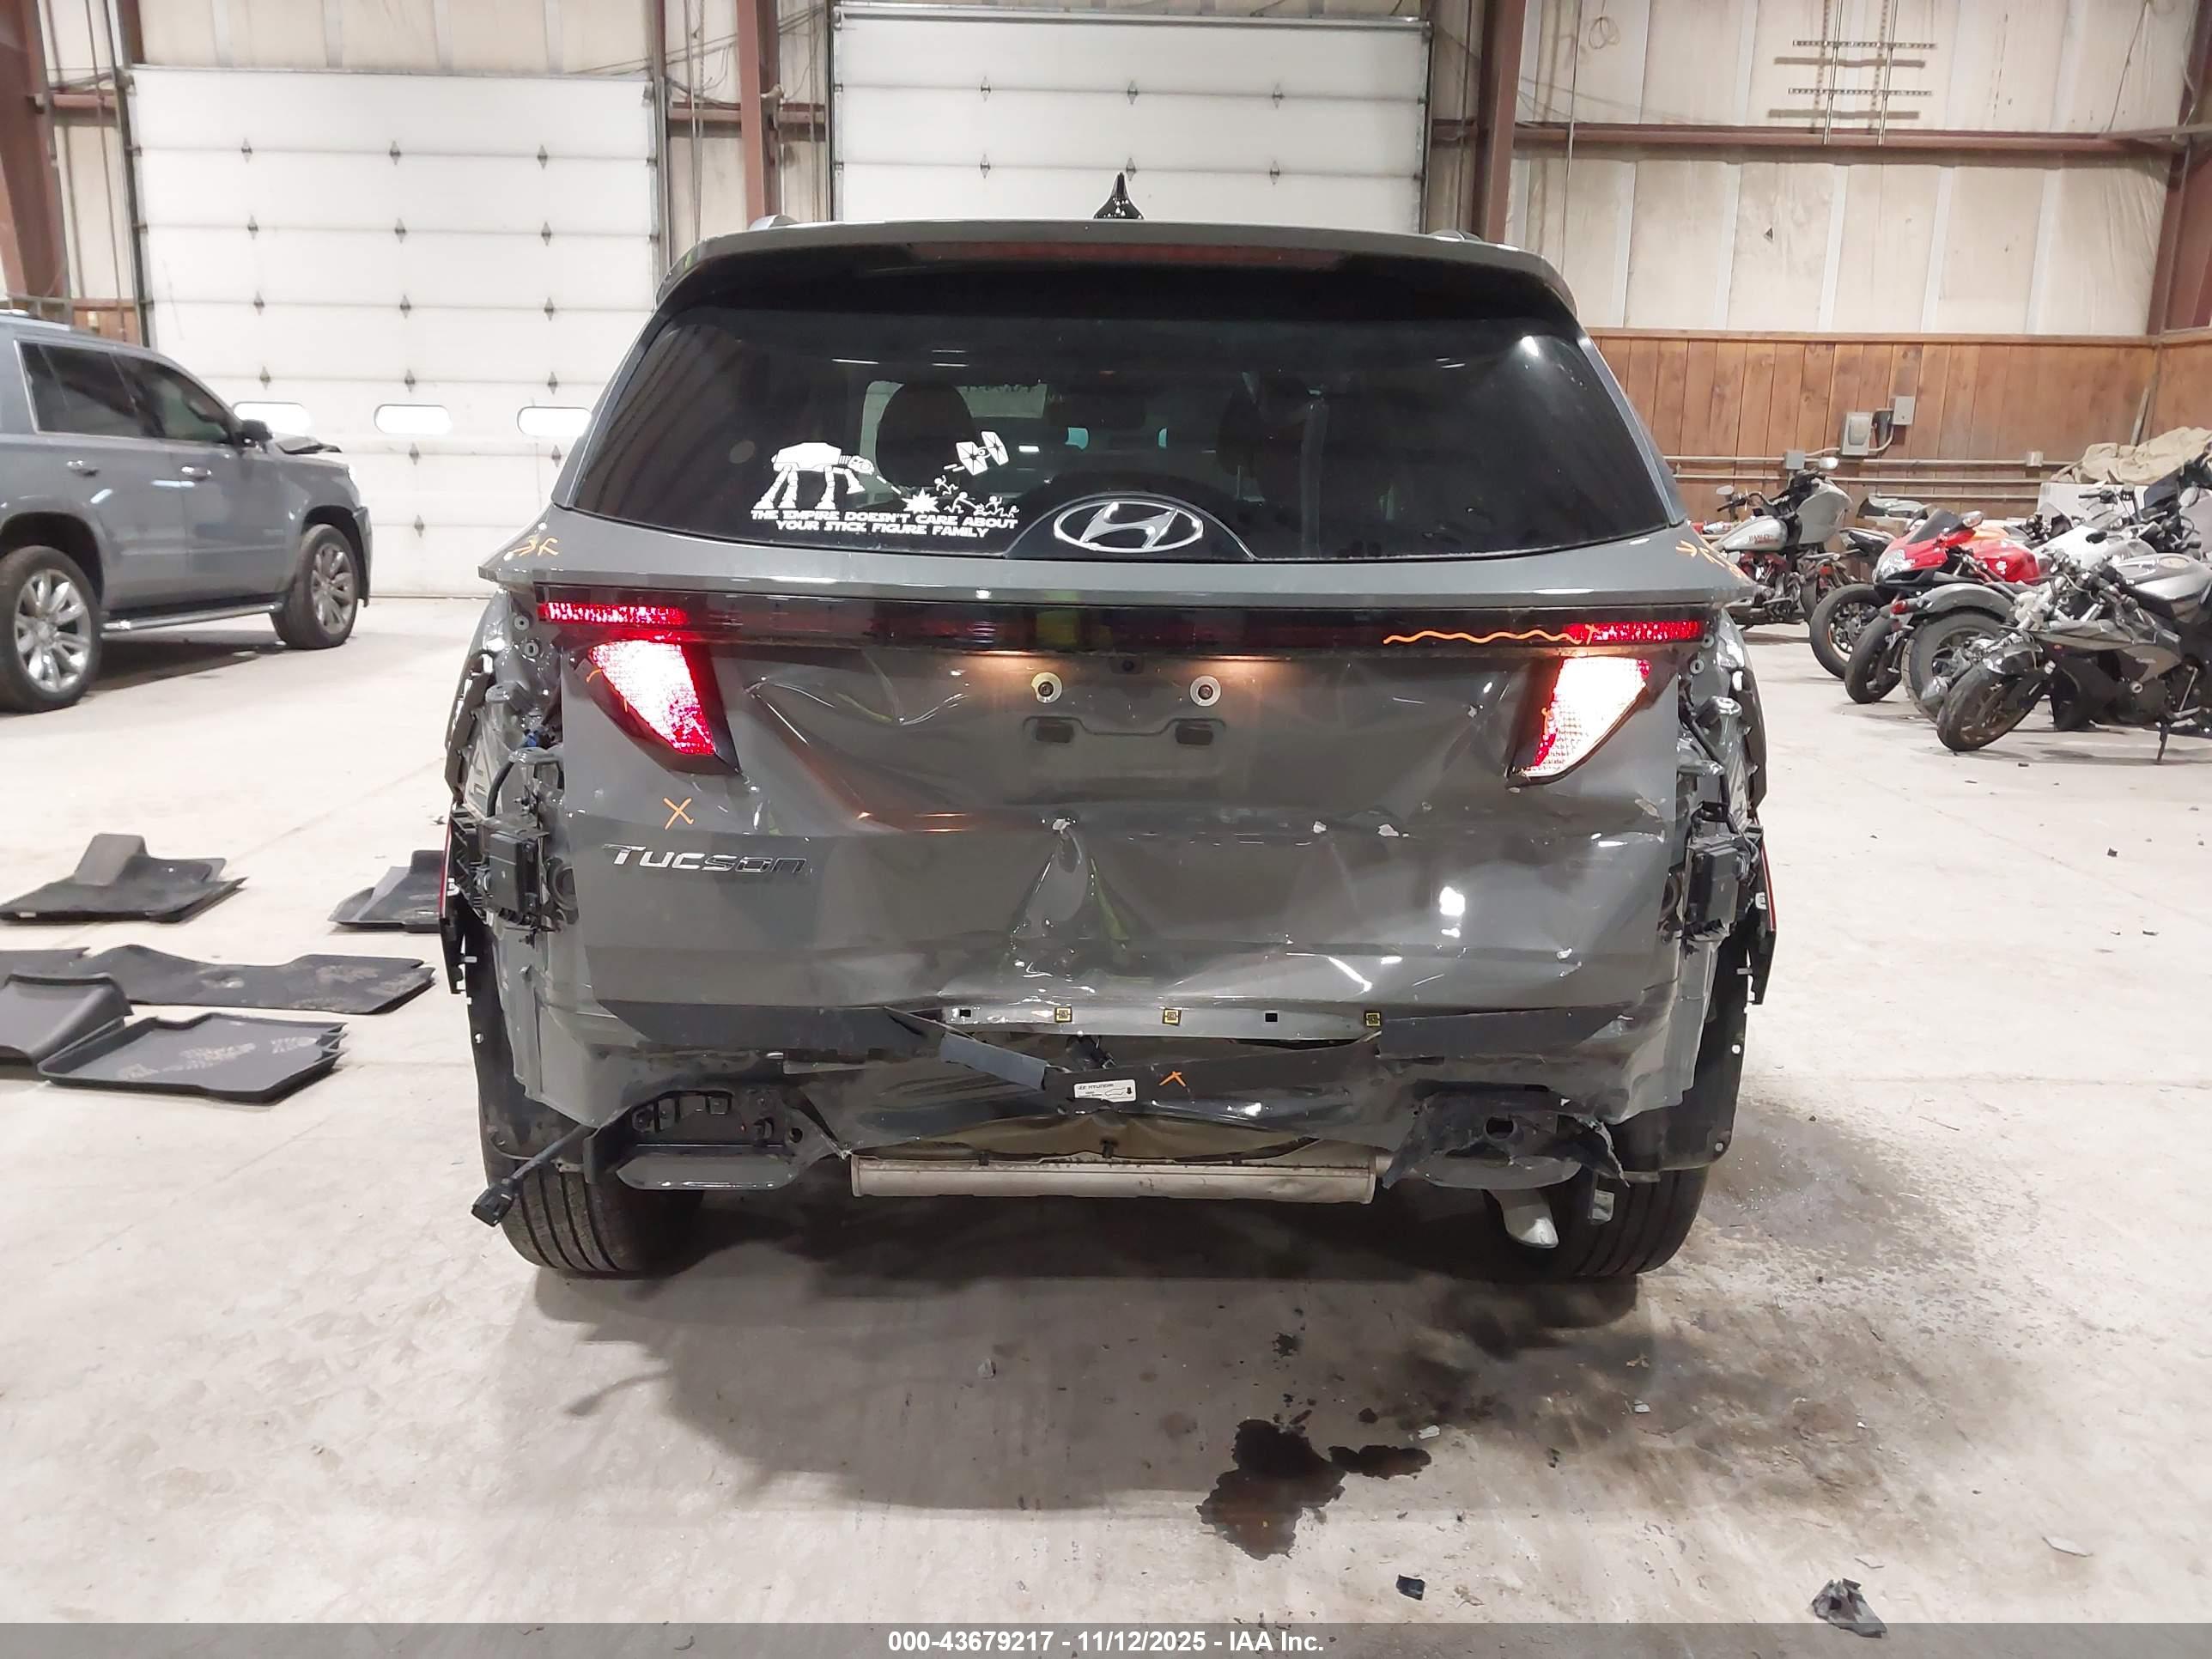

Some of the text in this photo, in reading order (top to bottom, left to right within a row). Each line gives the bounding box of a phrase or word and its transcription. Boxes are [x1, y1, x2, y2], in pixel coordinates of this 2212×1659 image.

[750, 509, 1018, 529] THE EMPIRE DOESN'T CARE ABOUT
[775, 520, 990, 538] YOUR STICK FIGURE FAMILY
